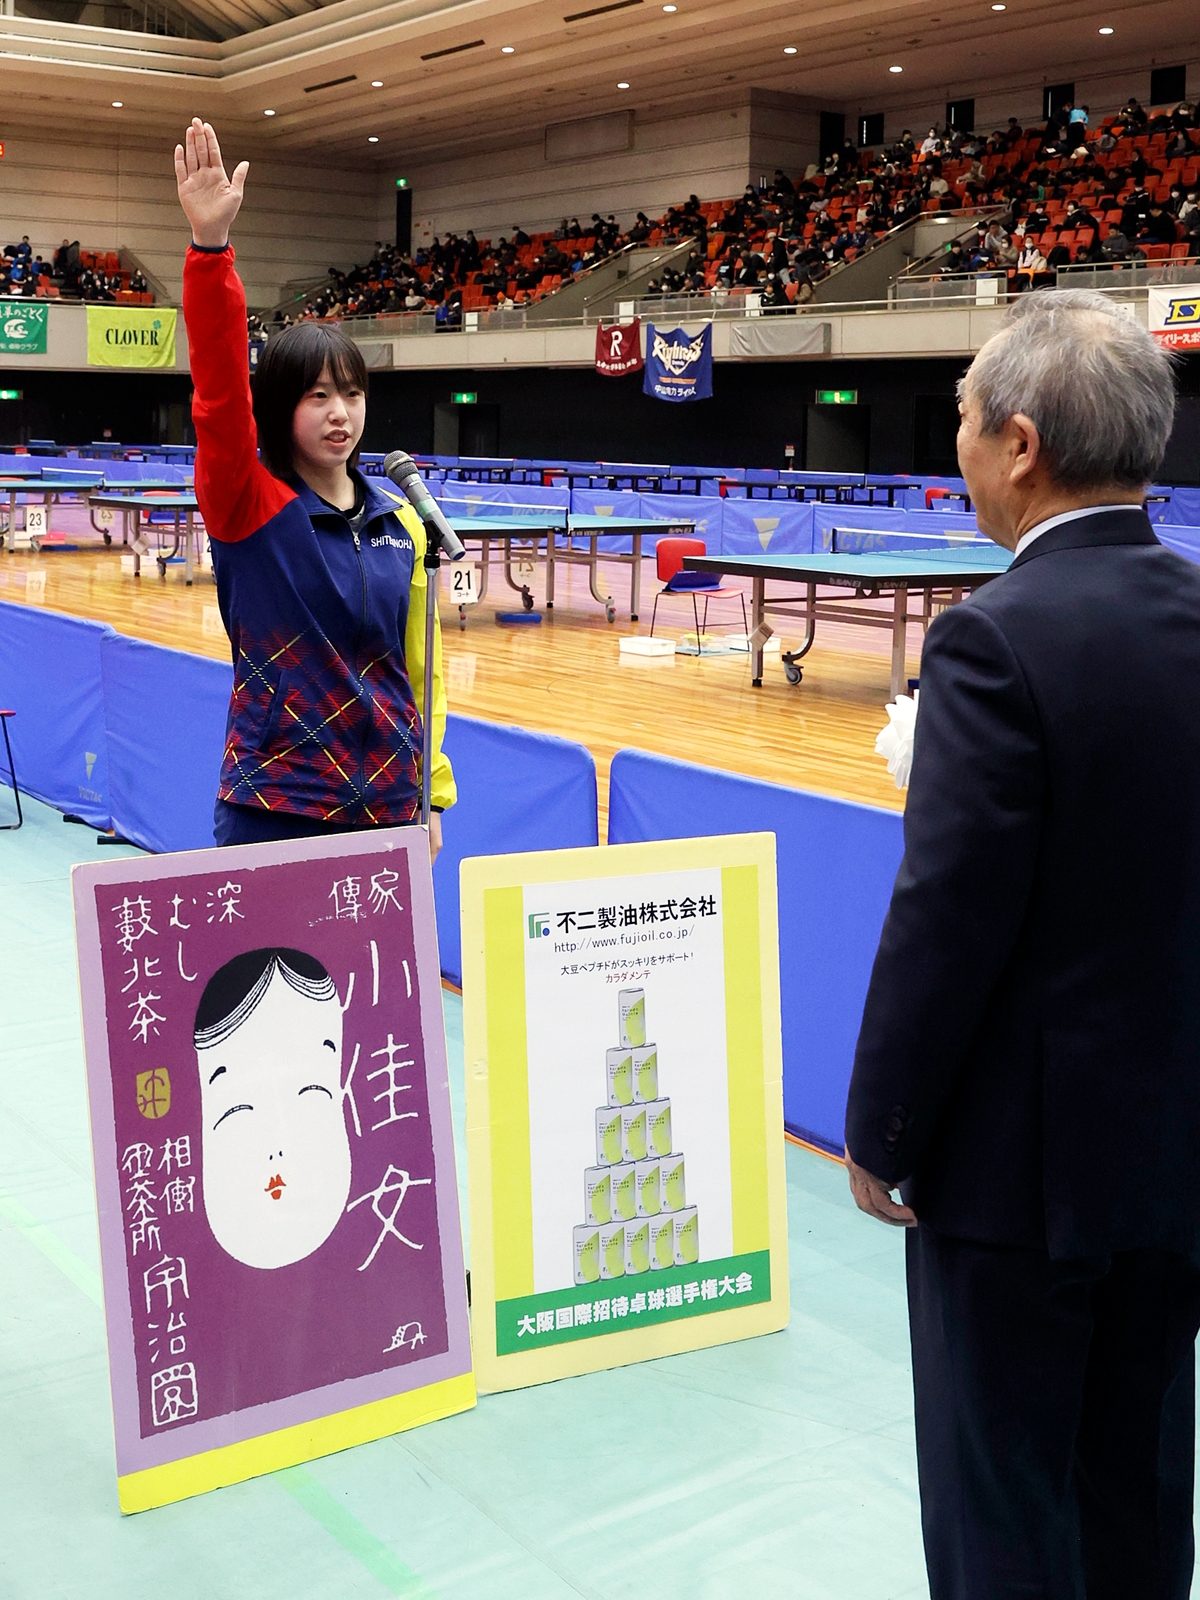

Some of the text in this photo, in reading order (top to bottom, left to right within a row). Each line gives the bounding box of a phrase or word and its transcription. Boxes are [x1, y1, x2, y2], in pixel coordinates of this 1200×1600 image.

[105, 328, 160, 346] CLOVER
[610, 330, 623, 357] R
[29, 512, 42, 527] 23
[453, 570, 472, 591] 21
[556, 894, 717, 934] 不二製油株式会社
[554, 924, 695, 954] http://www.fujioil.co.jp/
[605, 970, 651, 984] カラダメンテ
[517, 1272, 753, 1337] 大阪国際招待卓球選手権大会
